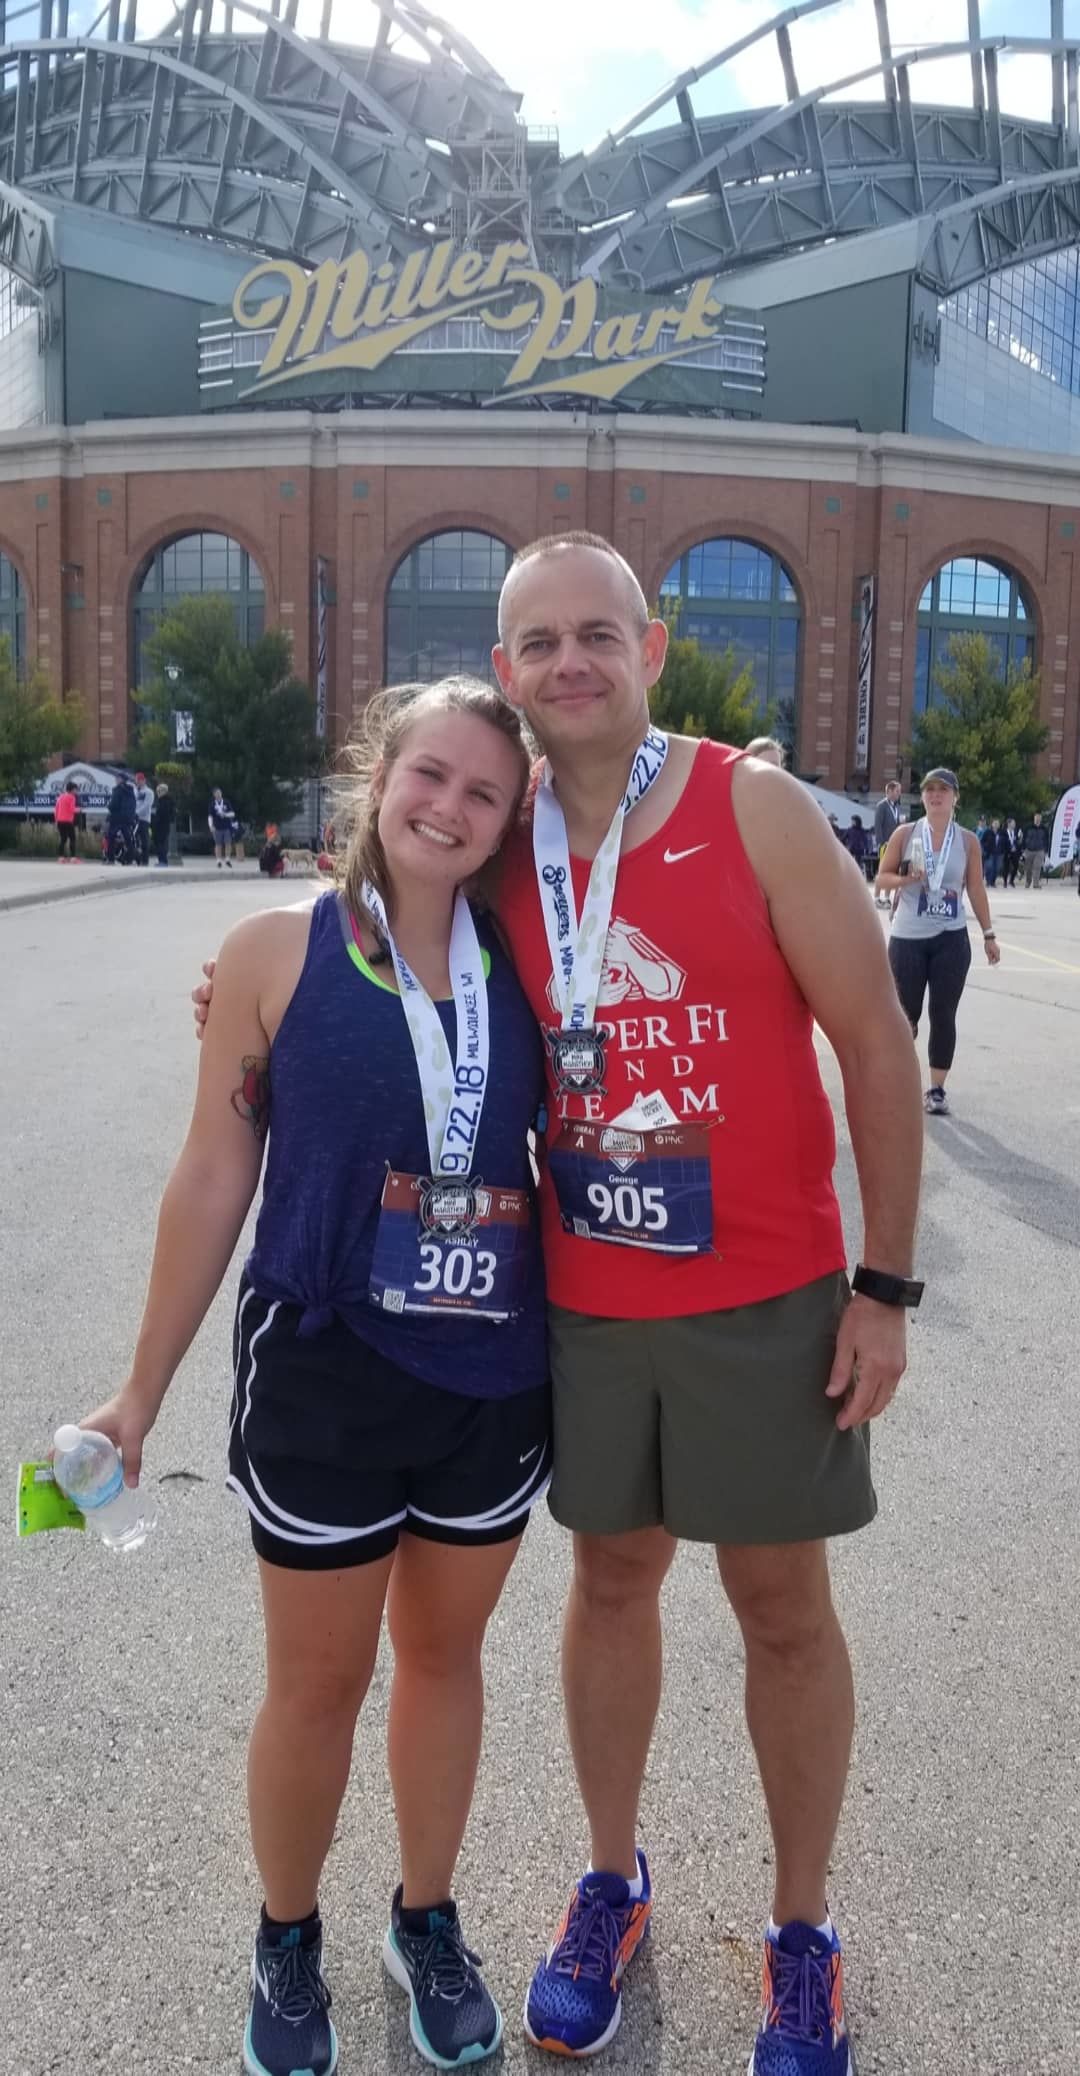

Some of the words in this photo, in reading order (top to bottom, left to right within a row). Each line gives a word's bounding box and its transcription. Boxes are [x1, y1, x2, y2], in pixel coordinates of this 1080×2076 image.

[232, 238, 529, 397] Miller
[480, 270, 722, 405] Park
[542, 864, 570, 941] Brewers
[461, 971, 475, 987] WI
[685, 1003, 730, 1045] FI
[440, 1065, 485, 1173] 9.22.18
[664, 1135, 684, 1145] PNC
[575, 1136, 585, 1149] A
[608, 1174, 639, 1186] George
[587, 1183, 668, 1231] 905
[413, 1244, 497, 1297] 303
